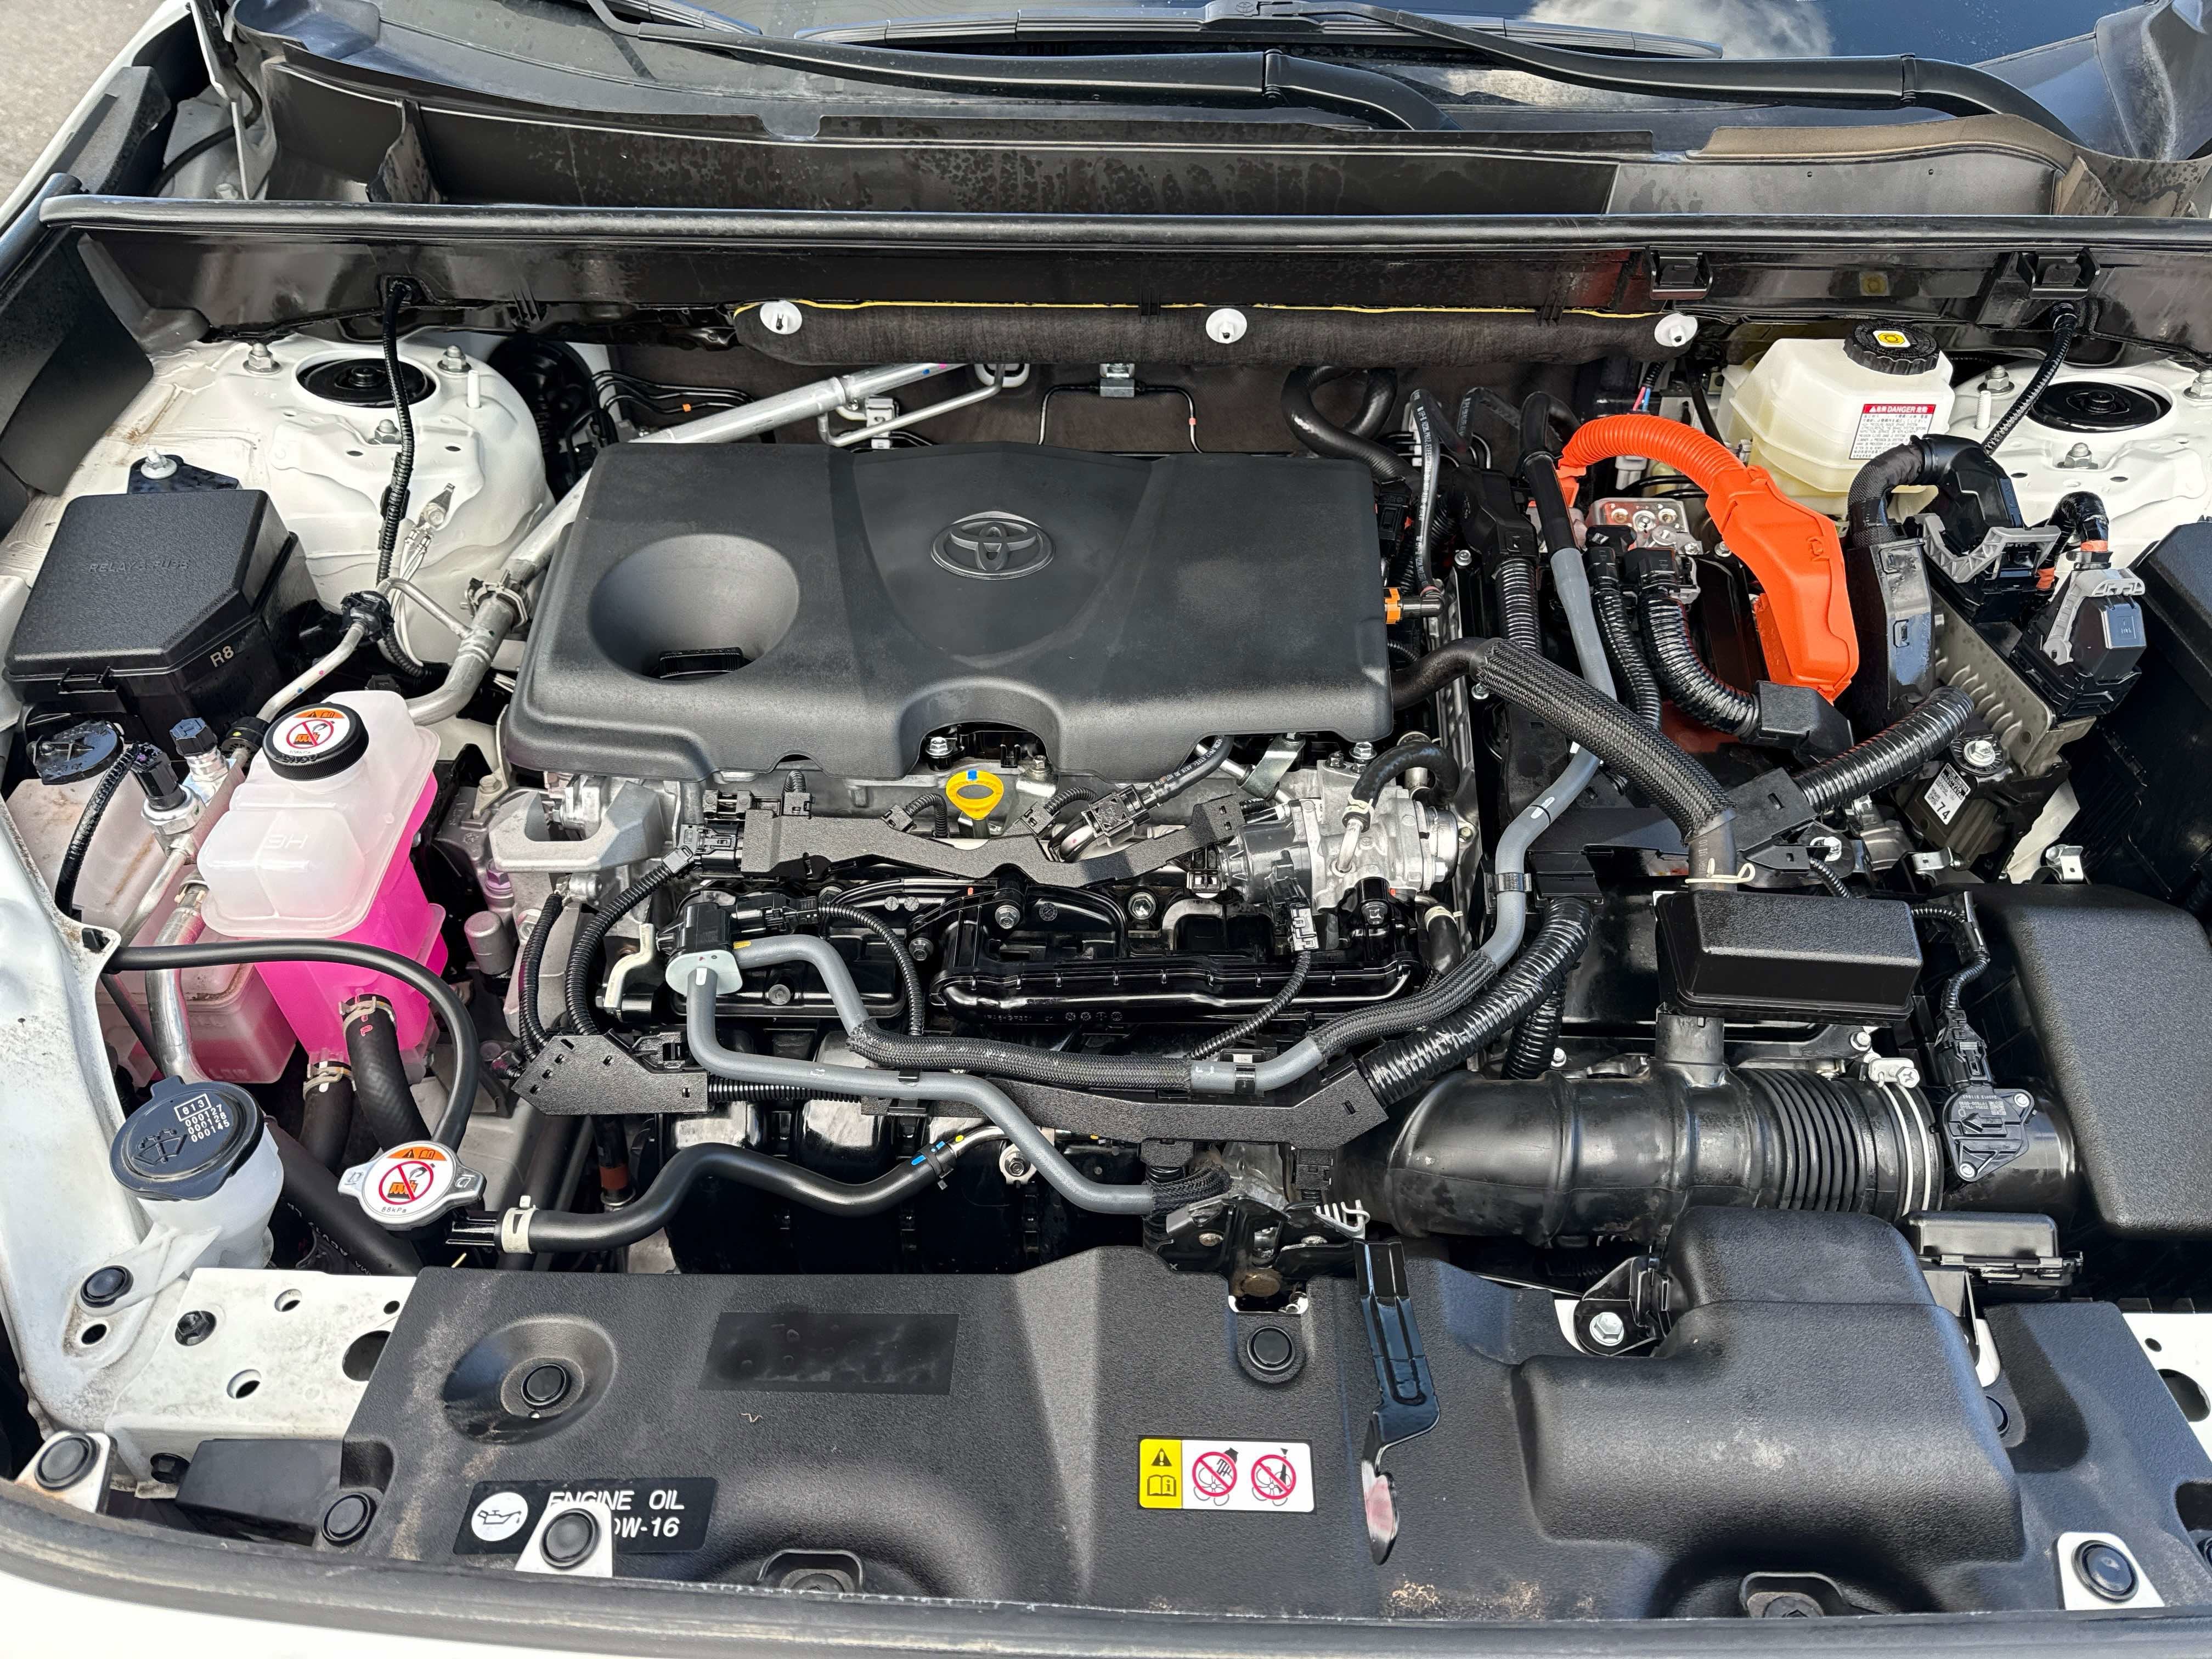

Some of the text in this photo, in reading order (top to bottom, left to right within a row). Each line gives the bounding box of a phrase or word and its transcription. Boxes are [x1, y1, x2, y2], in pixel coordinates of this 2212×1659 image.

[88, 561, 137, 572] RELAY
[210, 646, 234, 668] R8
[1948, 773, 1962, 792] TOYOTA
[1937, 802, 1950, 820] 74
[185, 1104, 222, 1127] 000127
[188, 1112, 227, 1135] 000128
[191, 1120, 230, 1142] 000145
[648, 1489, 685, 1510] OIL
